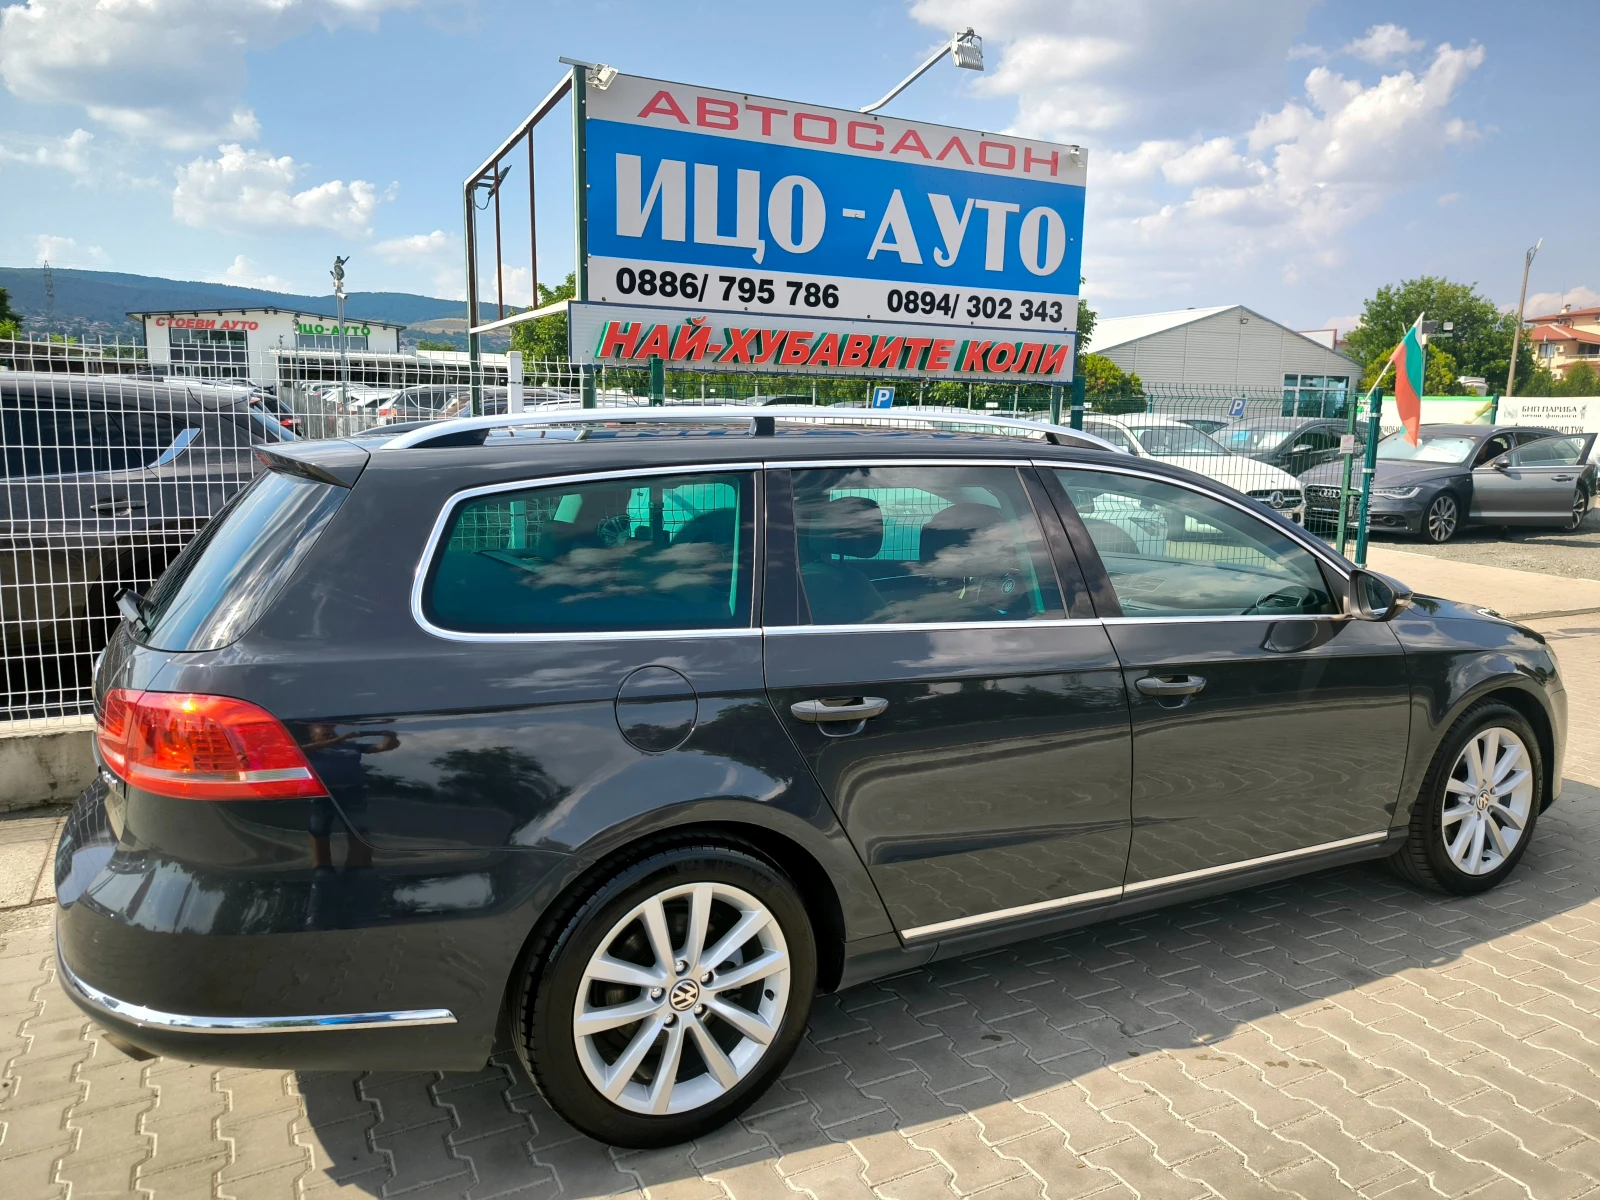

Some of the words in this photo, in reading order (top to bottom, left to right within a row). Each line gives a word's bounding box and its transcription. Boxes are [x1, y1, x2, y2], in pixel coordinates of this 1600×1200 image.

[637, 90, 1059, 177] АВТОСАЛОН
[616, 267, 709, 303] 0886/
[718, 275, 775, 305] 795
[786, 280, 840, 309] 786
[887, 289, 960, 319] 0894/
[966, 295, 1012, 320] 302
[1019, 299, 1063, 323] 343
[155, 317, 216, 329] СТОЕВИ
[220, 319, 259, 331] АУТО
[596, 315, 956, 371] НАЙ-ХУБАВИТЕ
[956, 340, 1069, 375] КОЛИ
[876, 389, 891, 407] P
[1231, 400, 1244, 415] P
